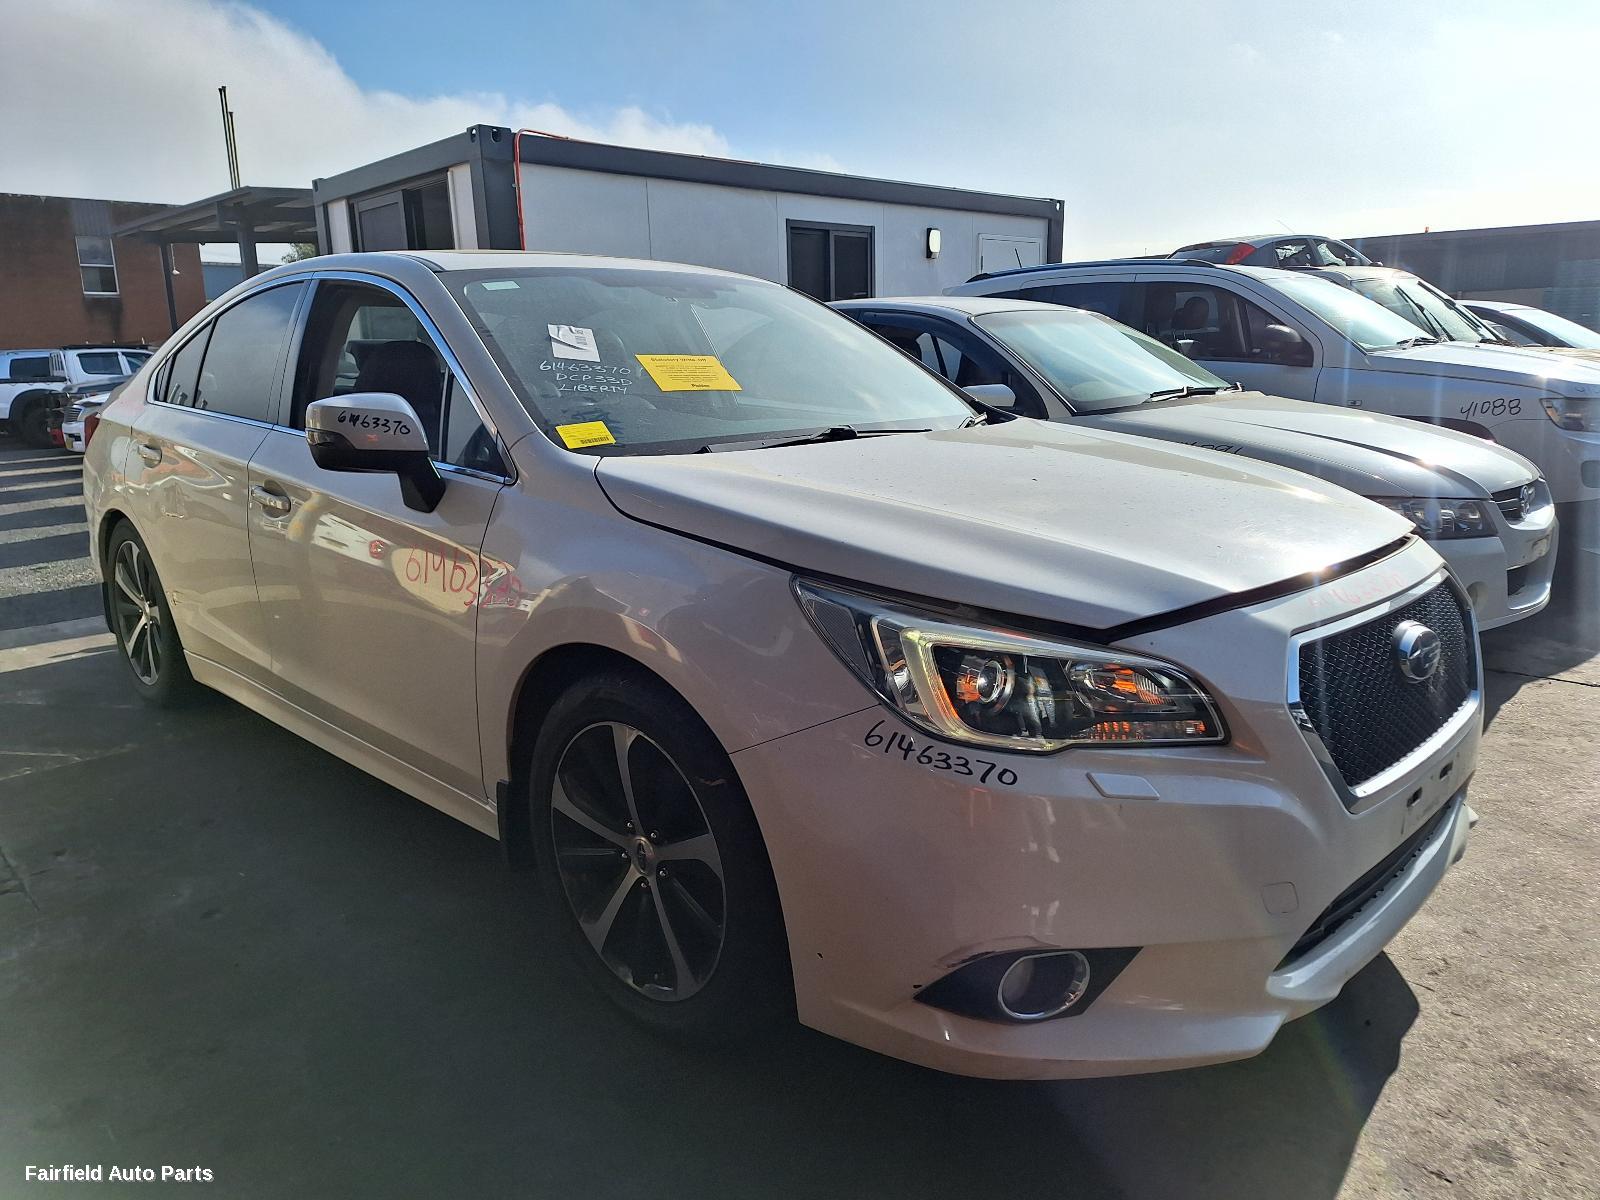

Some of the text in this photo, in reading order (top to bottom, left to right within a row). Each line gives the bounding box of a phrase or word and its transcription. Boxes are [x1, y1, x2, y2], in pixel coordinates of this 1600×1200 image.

[539, 360, 631, 375] 61463370
[557, 383, 628, 395] LIBERTY
[337, 410, 411, 436] 61463370
[864, 719, 1018, 786] 61463370
